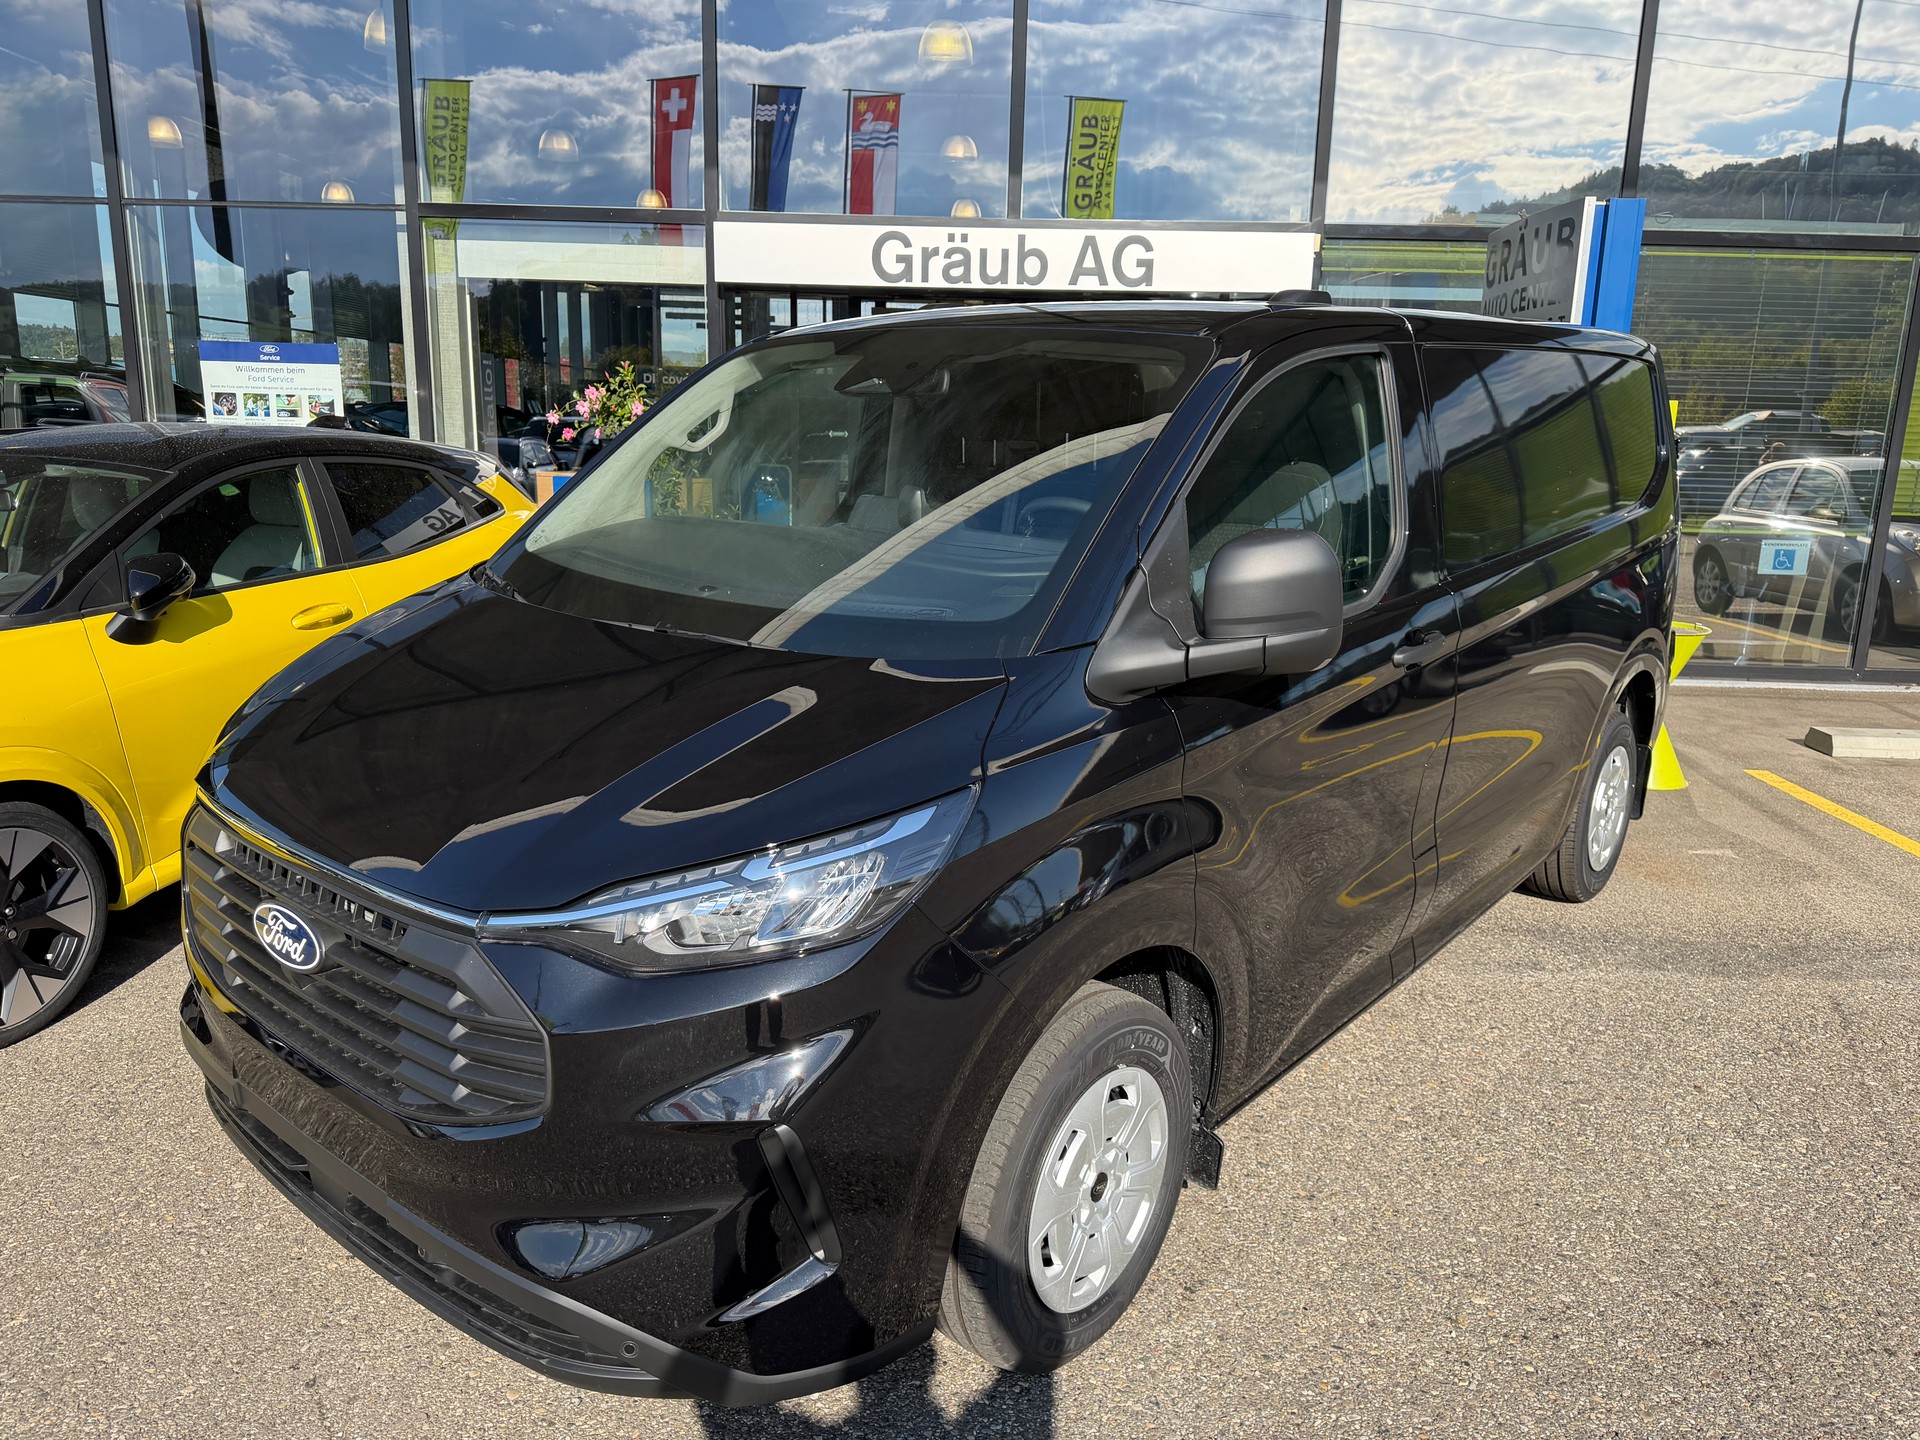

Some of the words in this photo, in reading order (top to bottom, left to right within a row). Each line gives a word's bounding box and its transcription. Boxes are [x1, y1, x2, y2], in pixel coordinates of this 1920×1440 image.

[447, 97, 461, 192] AUTOCENTER
[1073, 114, 1099, 212] GRÄUB
[1093, 115, 1112, 210] AUTOCENTER
[871, 230, 1049, 287] Gräub
[1068, 234, 1156, 287] AG
[1485, 217, 1576, 289] GRÄUB
[235, 365, 285, 374] Willkommen
[286, 366, 306, 374] beim
[247, 374, 266, 382] Ford
[267, 375, 295, 383] Service
[263, 911, 307, 962] Ford
